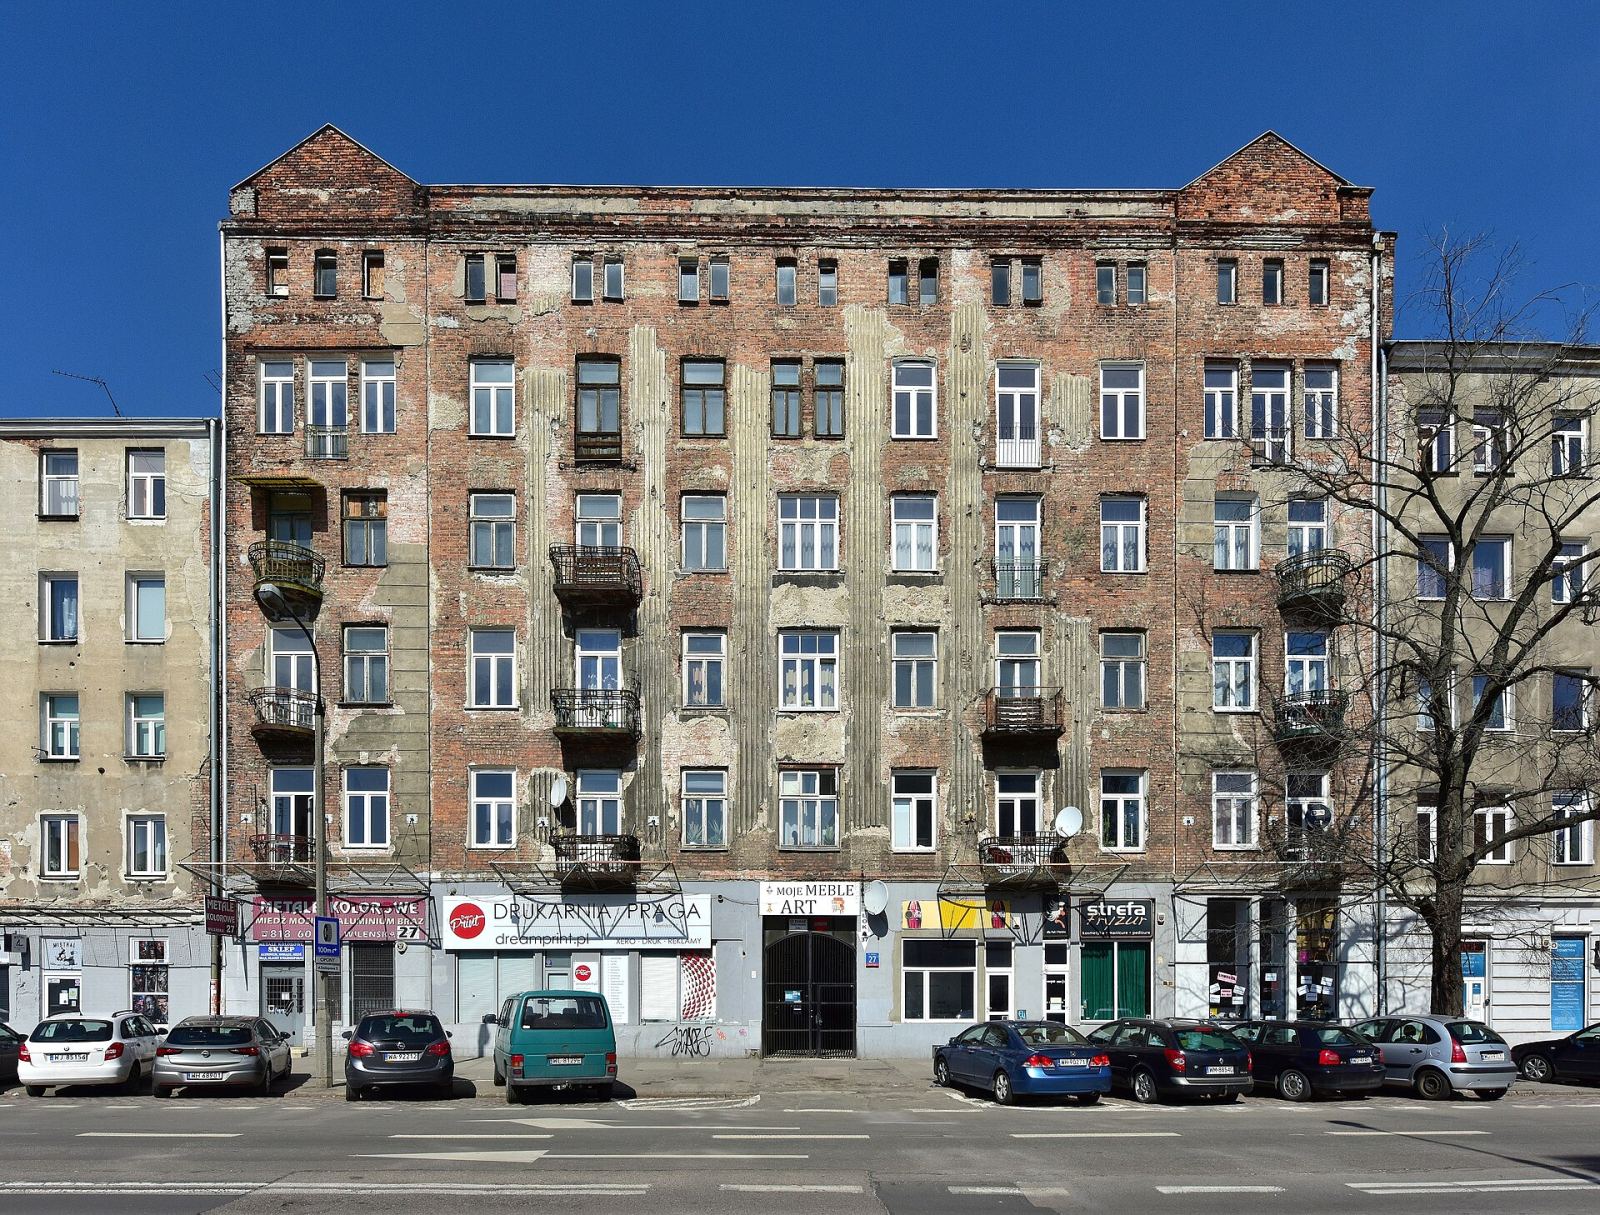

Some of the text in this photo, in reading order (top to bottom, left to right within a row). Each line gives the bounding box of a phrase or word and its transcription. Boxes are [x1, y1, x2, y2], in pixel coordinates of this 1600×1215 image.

[777, 884, 854, 897] MOJE MEBLE
[207, 900, 235, 912] METALE
[261, 901, 317, 914] METALE
[494, 903, 701, 919] DRUKARNIA PRAGA
[780, 900, 817, 914] ART
[1087, 902, 1146, 916] strefa
[226, 924, 235, 933] 27
[398, 926, 418, 938] 27
[495, 933, 589, 947] dreamprint.pl
[267, 945, 295, 953] SKLEP
[868, 955, 877, 963] 27
